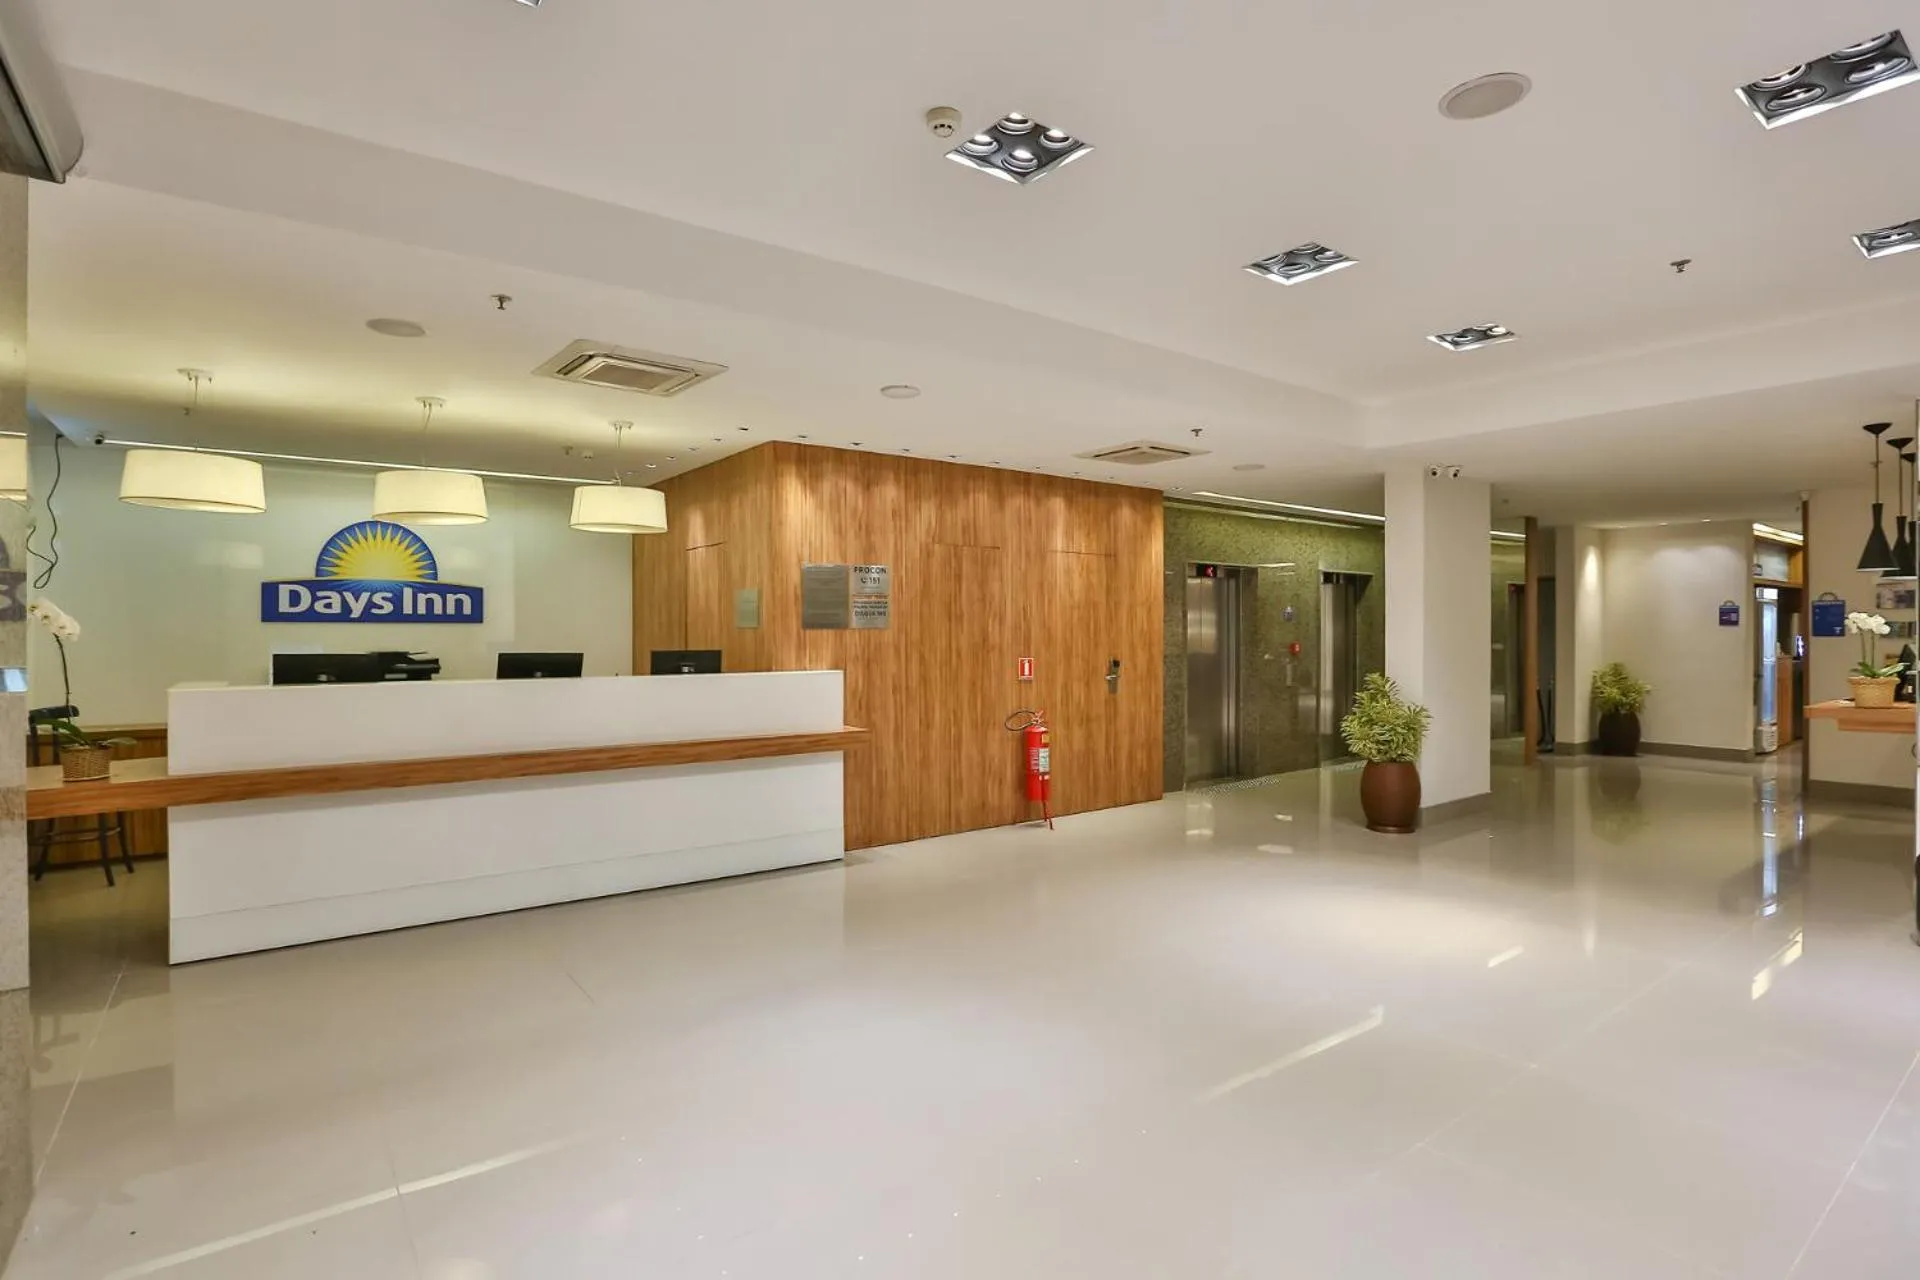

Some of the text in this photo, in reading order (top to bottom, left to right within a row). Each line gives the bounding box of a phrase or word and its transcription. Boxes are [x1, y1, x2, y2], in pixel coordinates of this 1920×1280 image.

[854, 566, 887, 574] PROCON
[278, 584, 472, 618] Days Inn
